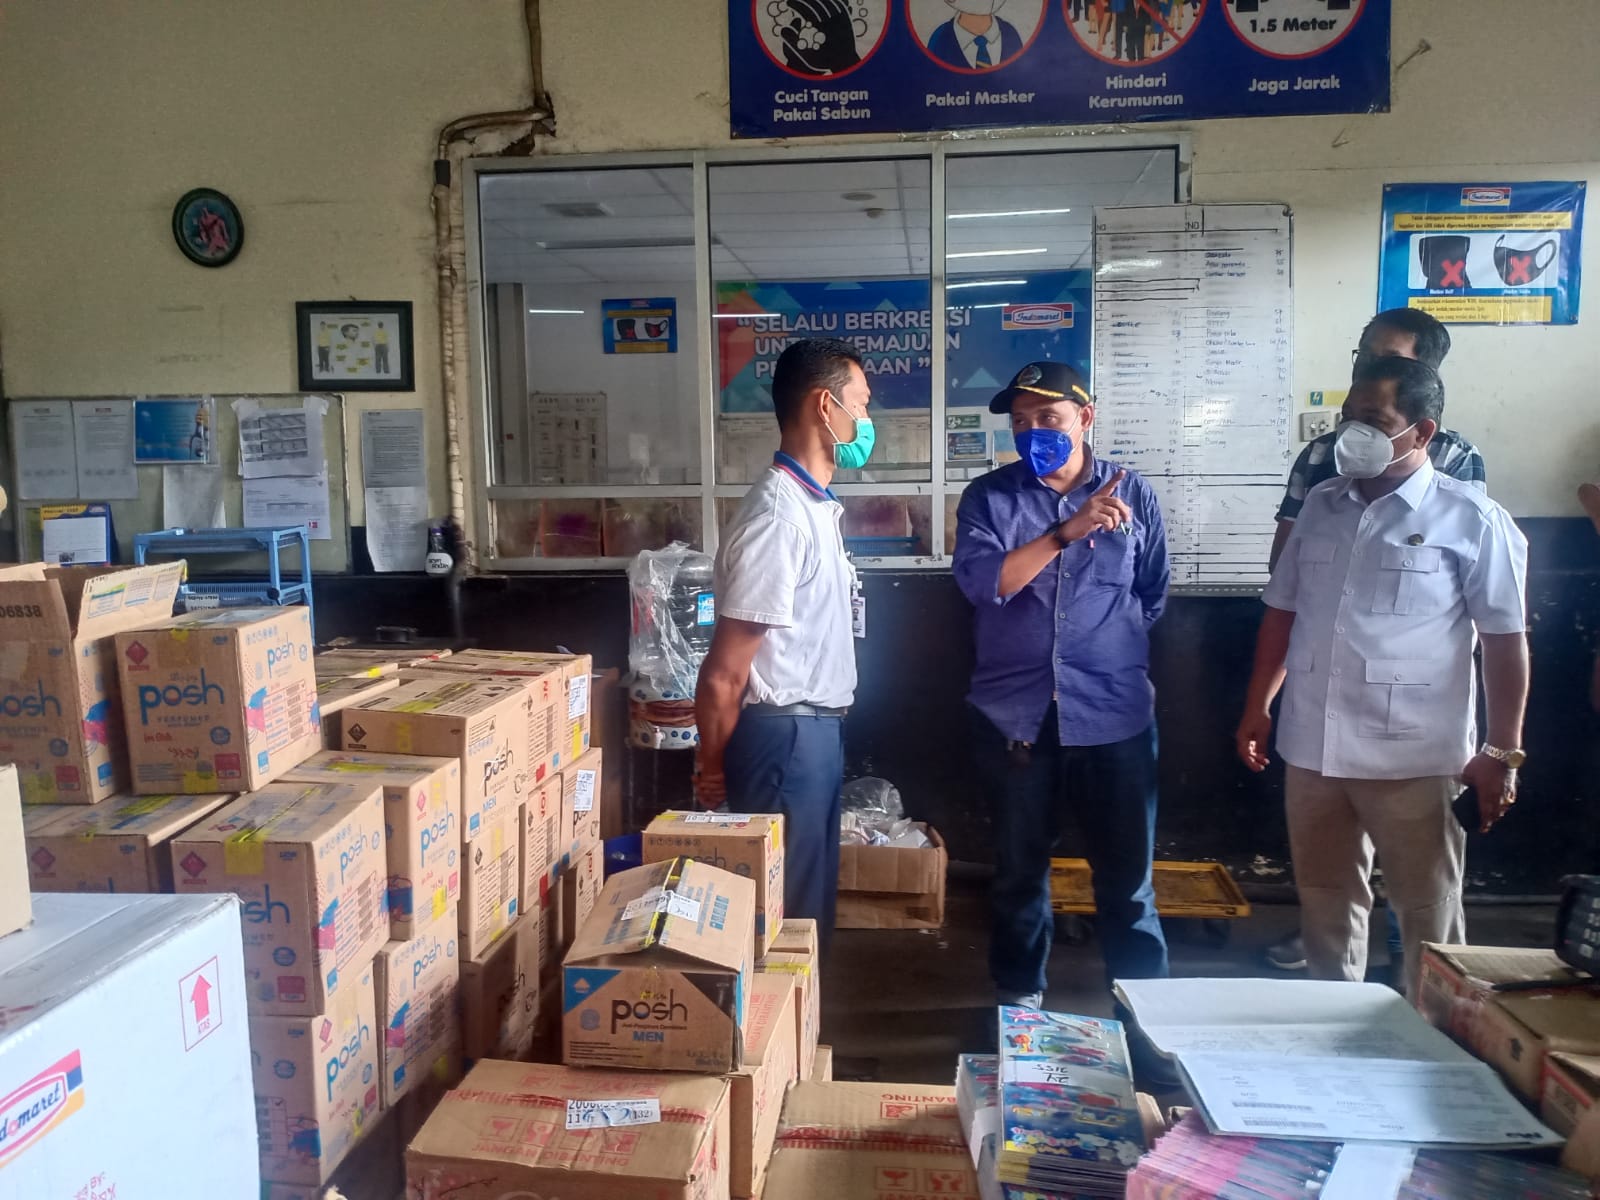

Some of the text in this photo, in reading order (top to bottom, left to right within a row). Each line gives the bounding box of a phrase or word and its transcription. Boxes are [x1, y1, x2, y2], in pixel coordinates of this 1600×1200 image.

[1250, 18, 1337, 33] 1.5 Meter
[1106, 73, 1167, 90] Hindari
[1249, 75, 1341, 95] Jaga Jarak
[774, 89, 869, 105] Cuci Tangan
[926, 90, 1036, 107] Pakai Masker
[1089, 93, 1184, 109] Kerumunan
[774, 107, 871, 122] Pakai Sabun
[845, 309, 970, 331] BERKRESI
[1015, 311, 1061, 322] Indomaret
[267, 632, 296, 679] posh
[0, 677, 62, 717] osh
[139, 667, 225, 726] posh
[421, 801, 456, 868] posh
[340, 832, 368, 885] posh
[413, 935, 443, 990] posh
[611, 989, 688, 1034] posh
[633, 1031, 664, 1042] MEN
[327, 1014, 371, 1103] posh
[475, 1142, 537, 1157] JANGAN
